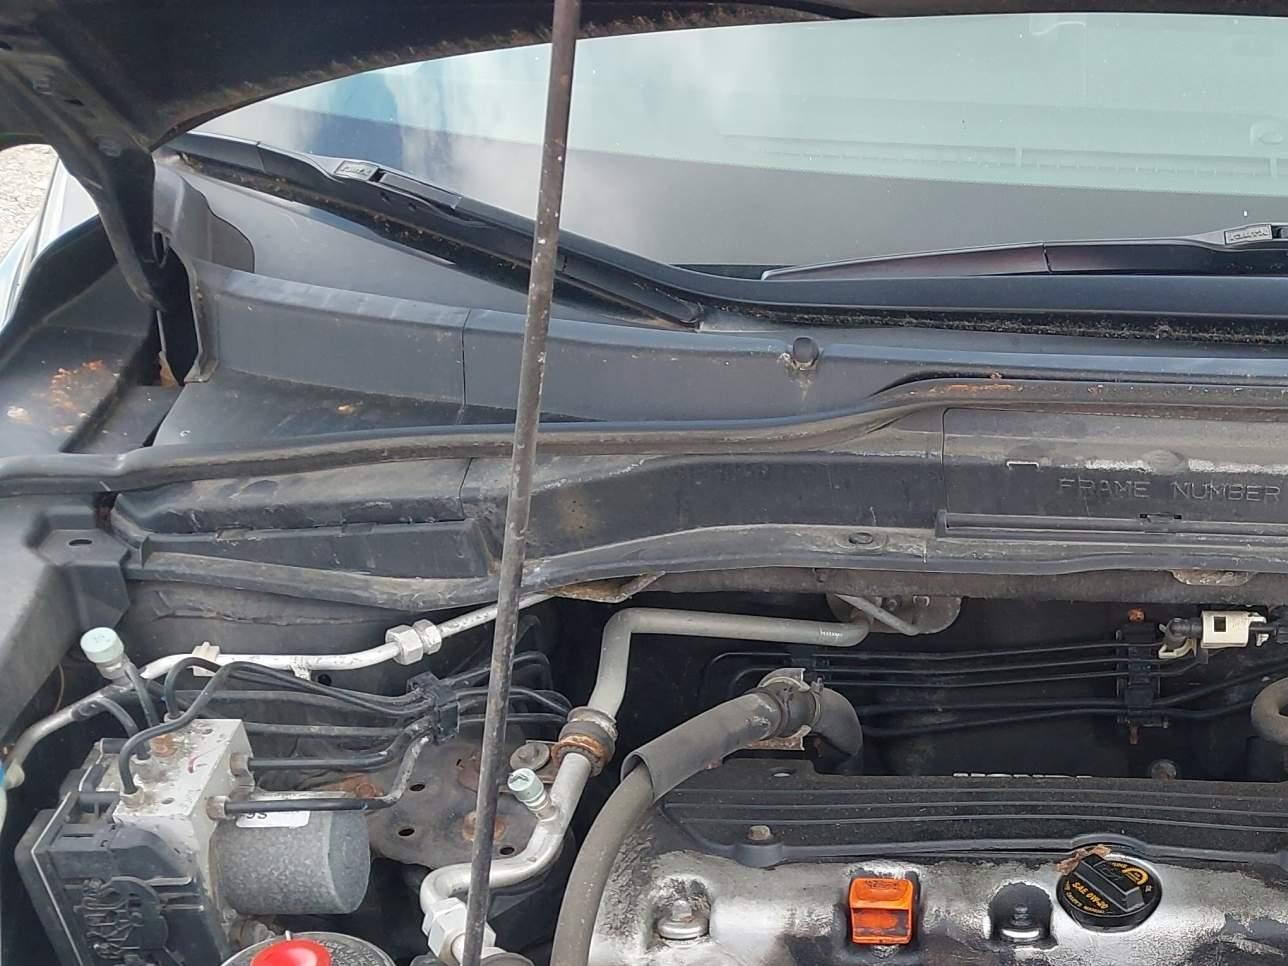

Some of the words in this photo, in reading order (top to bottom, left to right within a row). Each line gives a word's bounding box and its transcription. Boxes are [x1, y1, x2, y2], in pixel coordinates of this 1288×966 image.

[1058, 478, 1151, 500] FRAME
[1171, 481, 1281, 502] NUMBER
[1072, 881, 1086, 895] SAE
